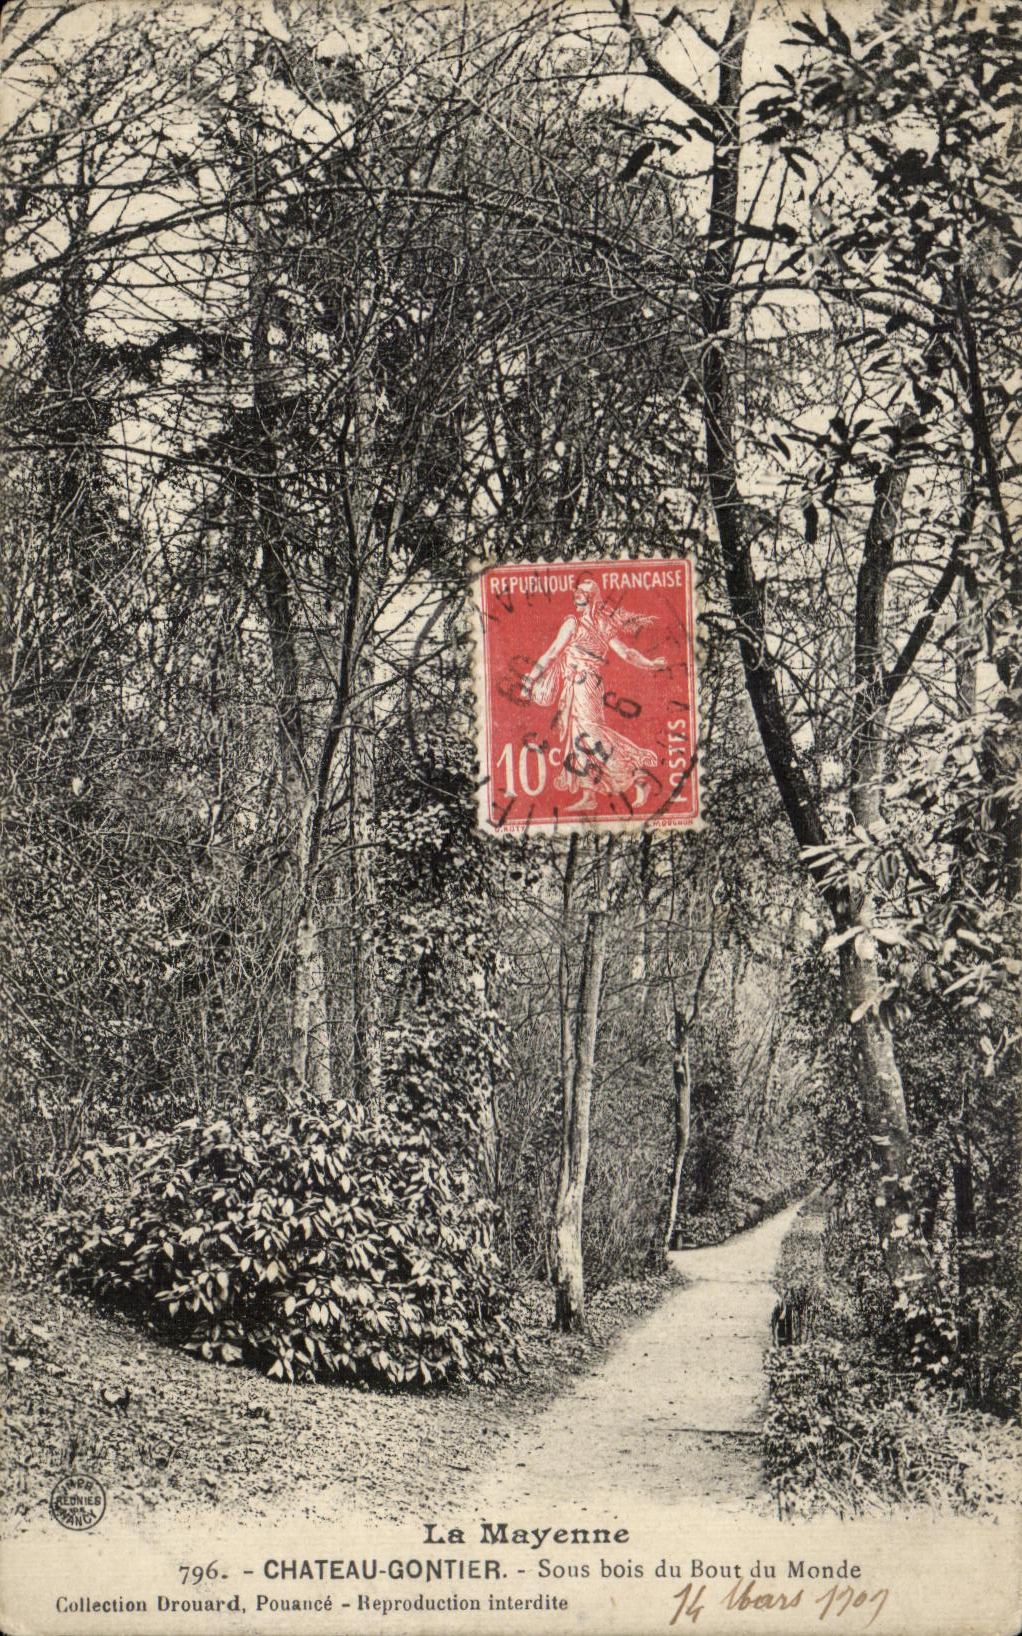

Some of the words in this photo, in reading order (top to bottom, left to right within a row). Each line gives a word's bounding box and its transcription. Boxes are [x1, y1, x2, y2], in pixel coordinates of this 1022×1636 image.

[602, 569, 683, 591] FRANÇAISE
[666, 718, 687, 804] POSTES
[423, 1523, 465, 1545] La
[480, 1523, 630, 1550] Mayenne
[179, 1560, 228, 1585] 796.
[263, 1559, 508, 1582] CHATEAU-GONTIER.
[538, 1559, 590, 1579] Sous
[600, 1558, 644, 1579] bois
[655, 1559, 682, 1579] du
[690, 1559, 741, 1579] Bout
[750, 1560, 776, 1580] du
[788, 1560, 862, 1580] Monde
[55, 1596, 148, 1613] Collection
[158, 1595, 247, 1614] Drouard,
[256, 1594, 333, 1612] Pouancé
[357, 1593, 481, 1616] Reproduction
[489, 1593, 569, 1612] interdite
[669, 1582, 706, 1626] 14
